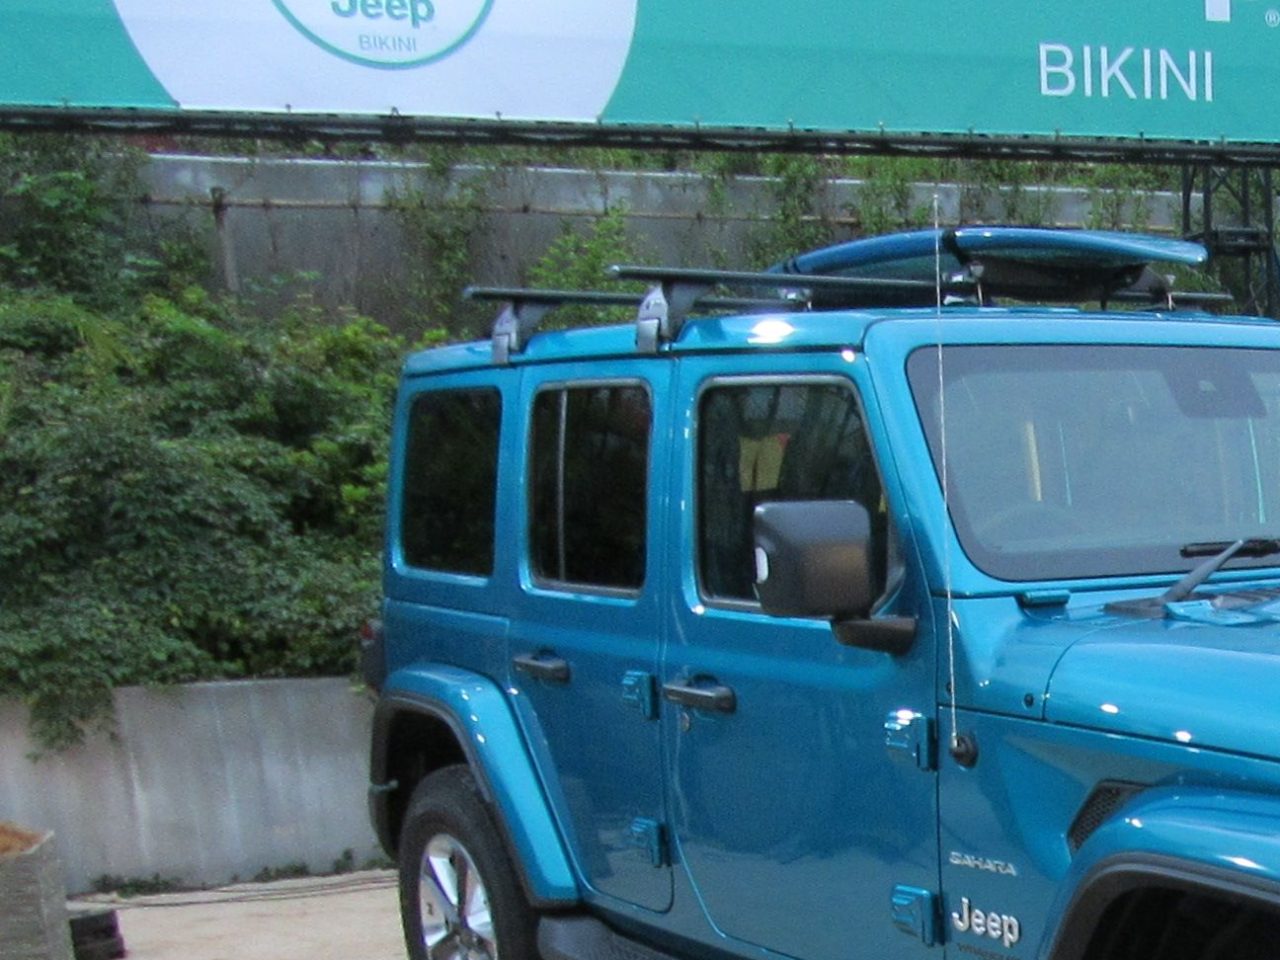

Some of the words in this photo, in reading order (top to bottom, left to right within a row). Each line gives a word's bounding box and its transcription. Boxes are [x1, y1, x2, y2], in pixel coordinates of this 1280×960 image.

[359, 34, 417, 52] BIKINI
[1039, 42, 1213, 101] BIKINI
[950, 851, 1017, 876] SAHARA
[951, 897, 1020, 948] Jeep
